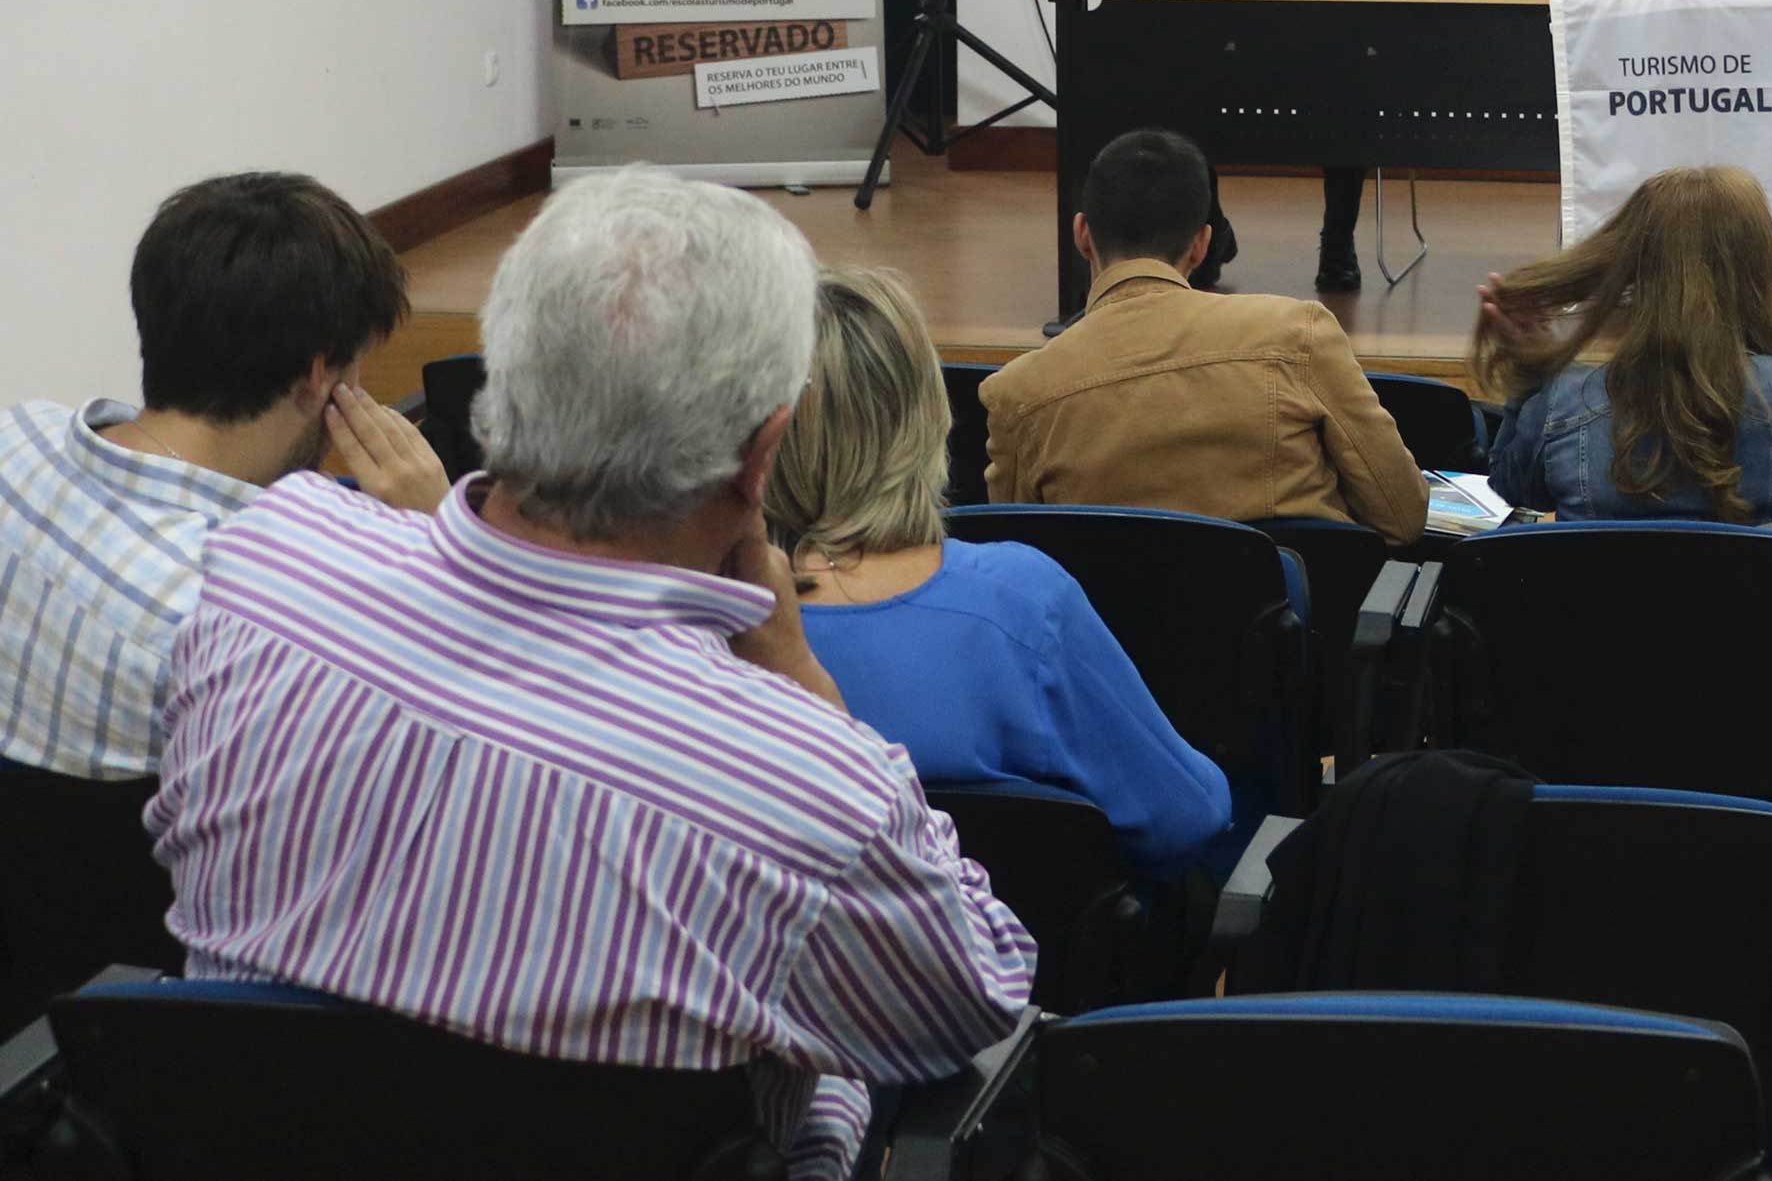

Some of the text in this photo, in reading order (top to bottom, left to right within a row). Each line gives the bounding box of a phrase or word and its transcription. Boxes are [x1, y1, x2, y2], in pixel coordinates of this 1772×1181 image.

[633, 22, 836, 66] RESERVADO
[706, 59, 859, 82] RESERVA O TEU LUGAR ENTRE
[1619, 54, 1753, 77] TURISMO DE
[708, 73, 846, 95] OS MELHORES DO MUNDO
[1608, 87, 1772, 117] PORTUGAL
